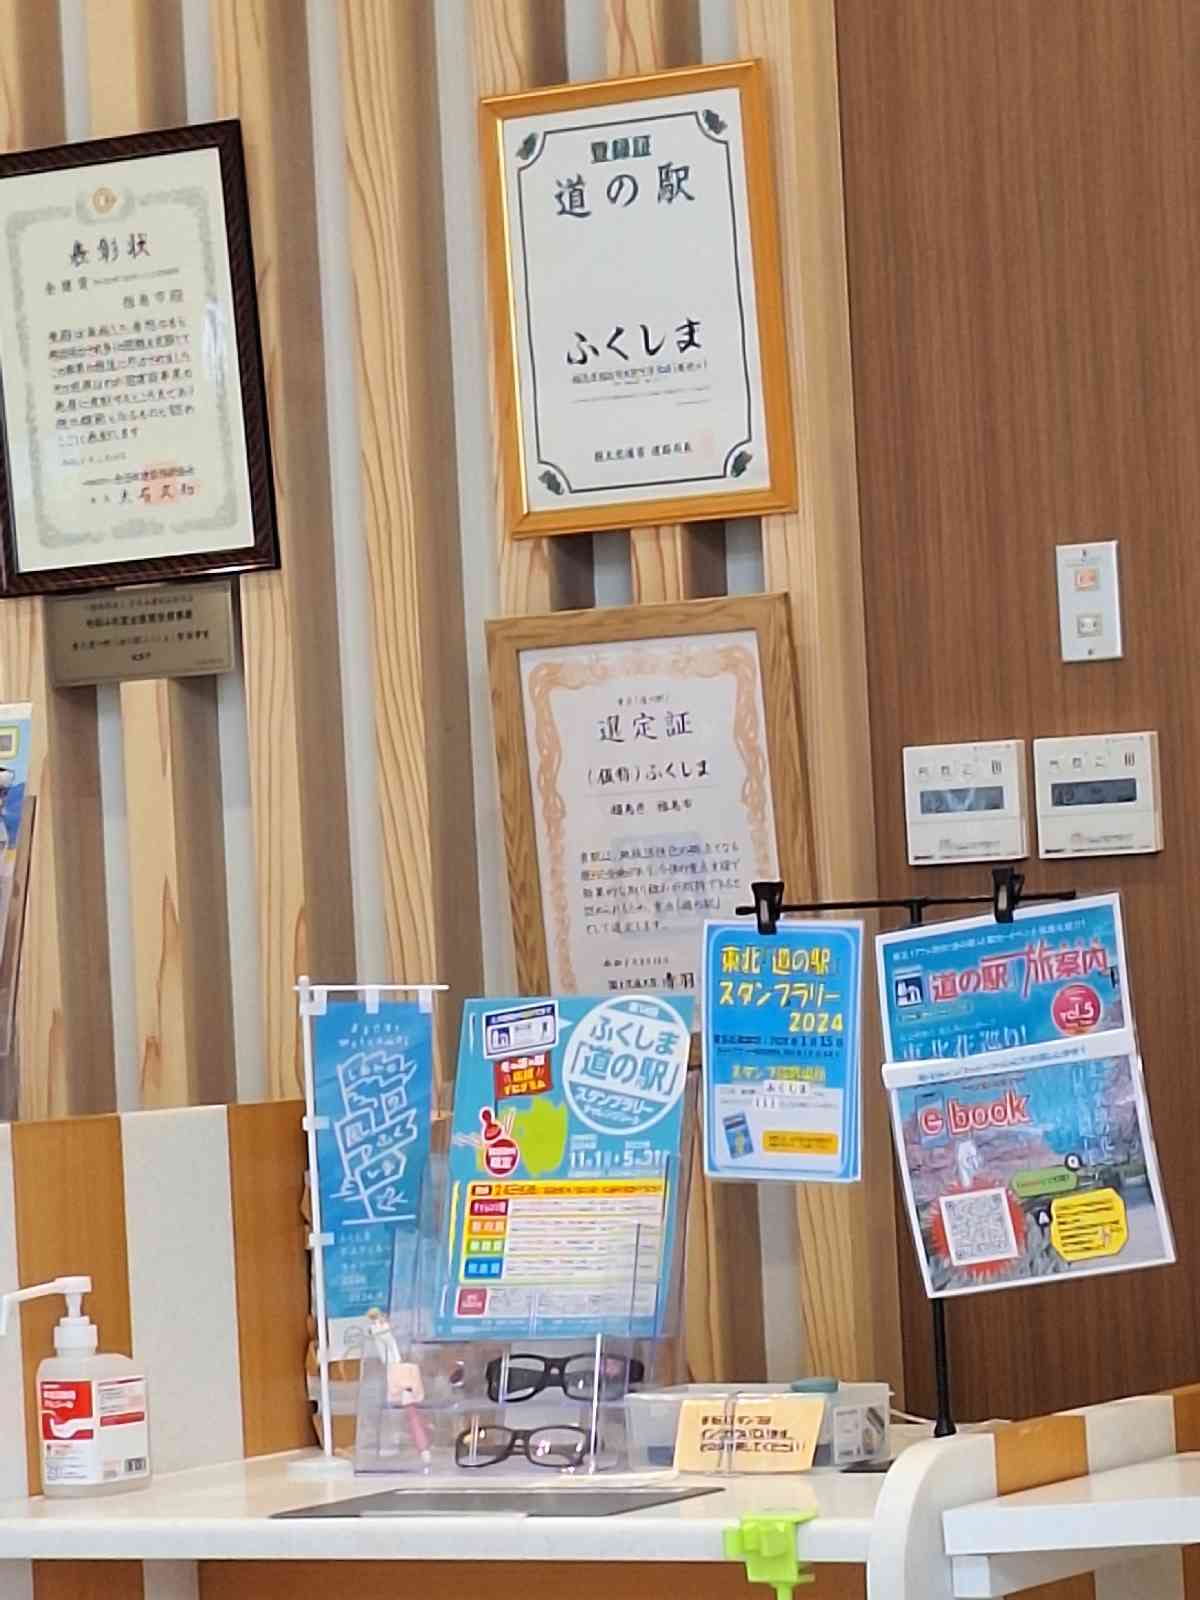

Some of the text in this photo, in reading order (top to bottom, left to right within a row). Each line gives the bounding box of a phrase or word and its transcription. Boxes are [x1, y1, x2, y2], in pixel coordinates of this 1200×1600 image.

[554, 161, 695, 218] 道の駅
[566, 316, 702, 365] ふくしま
[597, 711, 693, 743] 選定証
[719, 980, 841, 1008] スタンプラリー
[589, 1017, 681, 1056] ふくしま
[788, 1011, 844, 1034] 2024
[570, 1042, 681, 1097] 「道の駅」
[947, 1089, 1030, 1133] book
